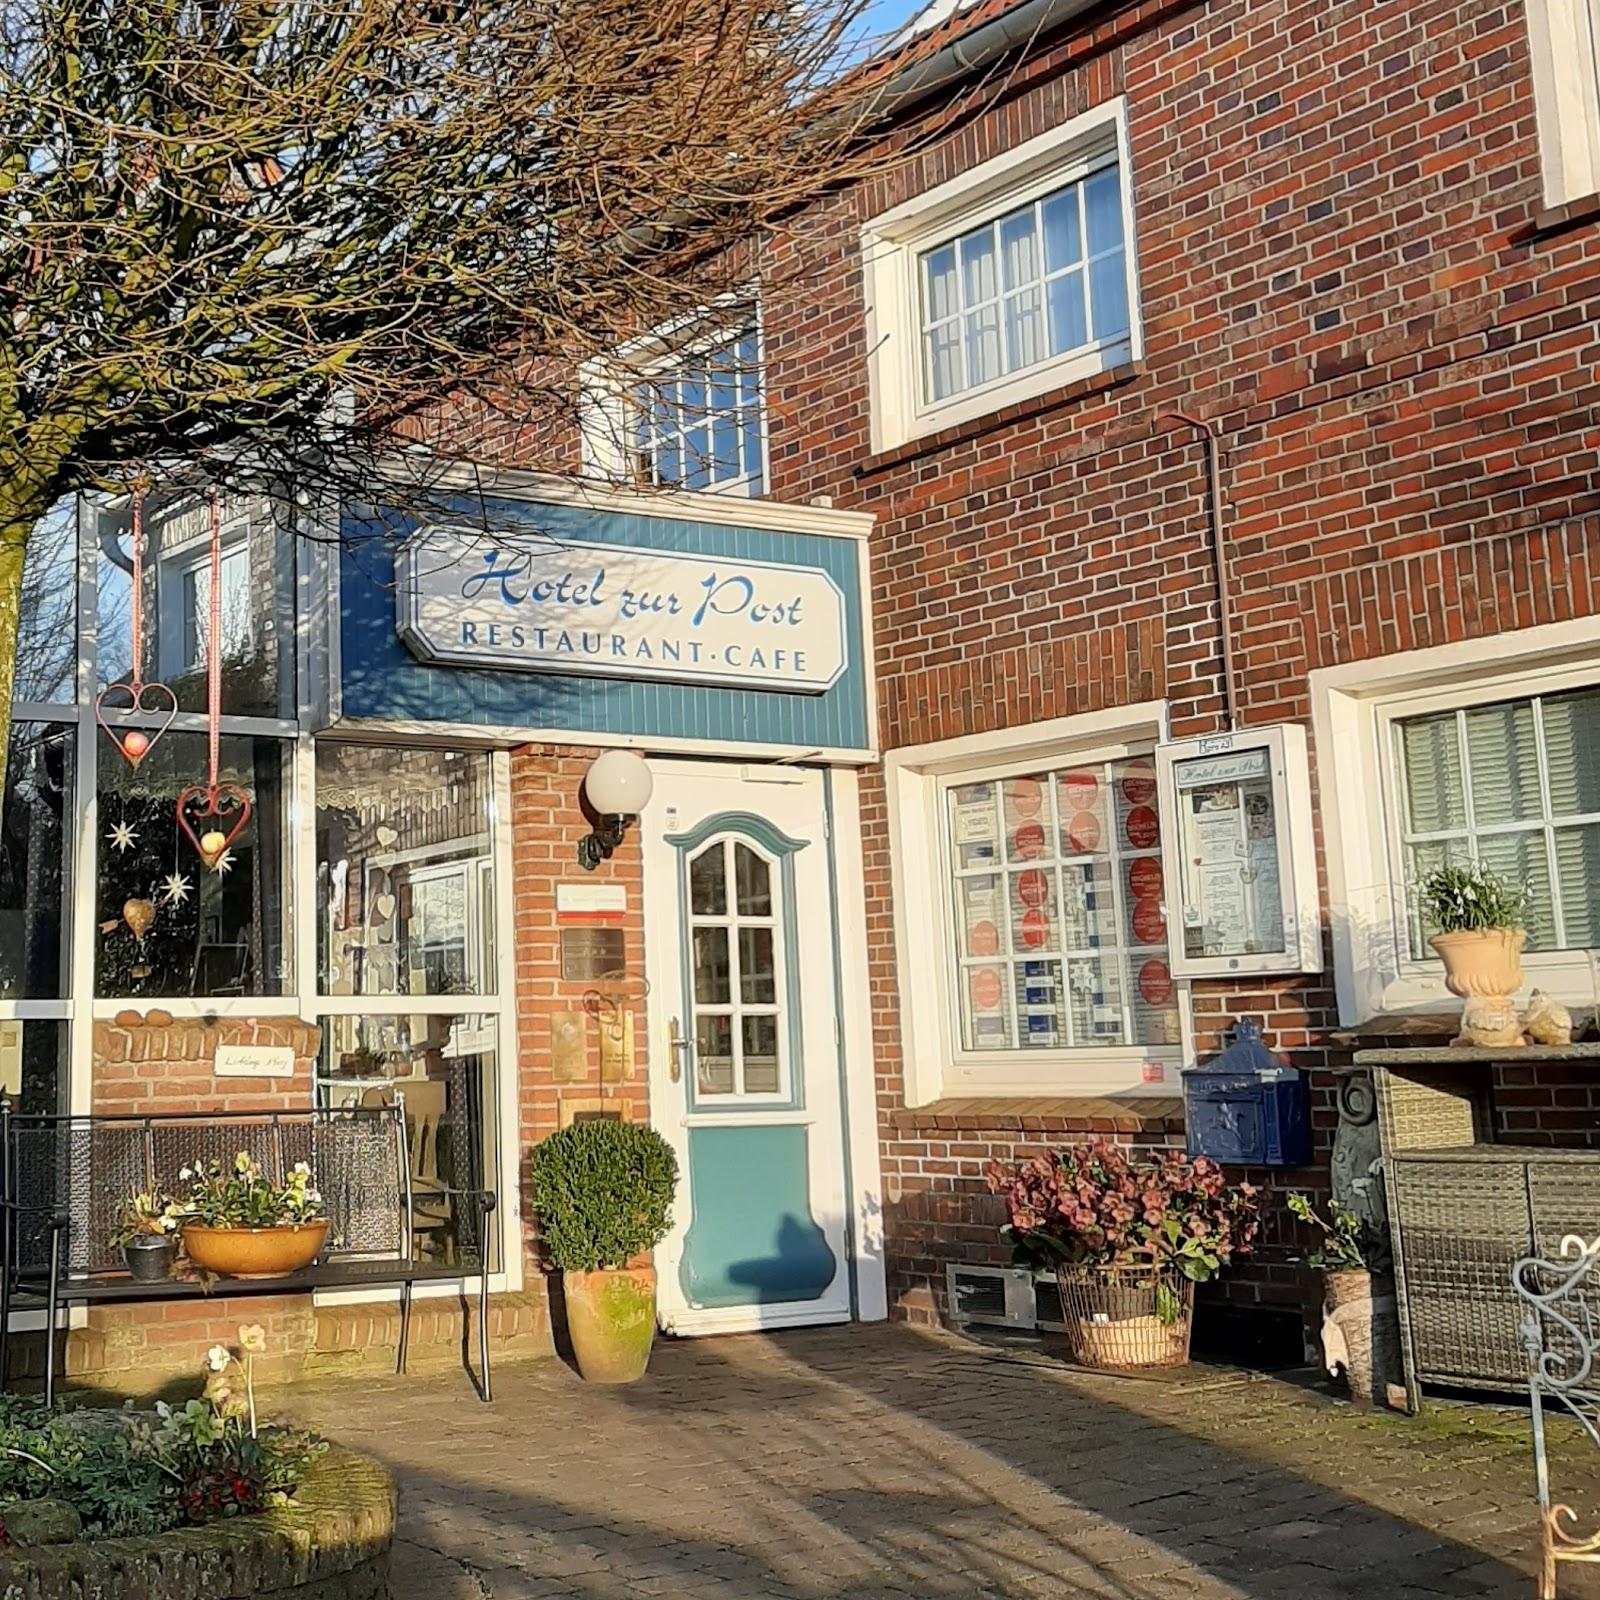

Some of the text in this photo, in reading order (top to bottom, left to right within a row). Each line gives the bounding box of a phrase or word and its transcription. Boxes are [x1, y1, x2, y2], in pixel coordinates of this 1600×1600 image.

[461, 549, 804, 626] Hotel zur Post
[462, 622, 704, 663] RESTAURANT
